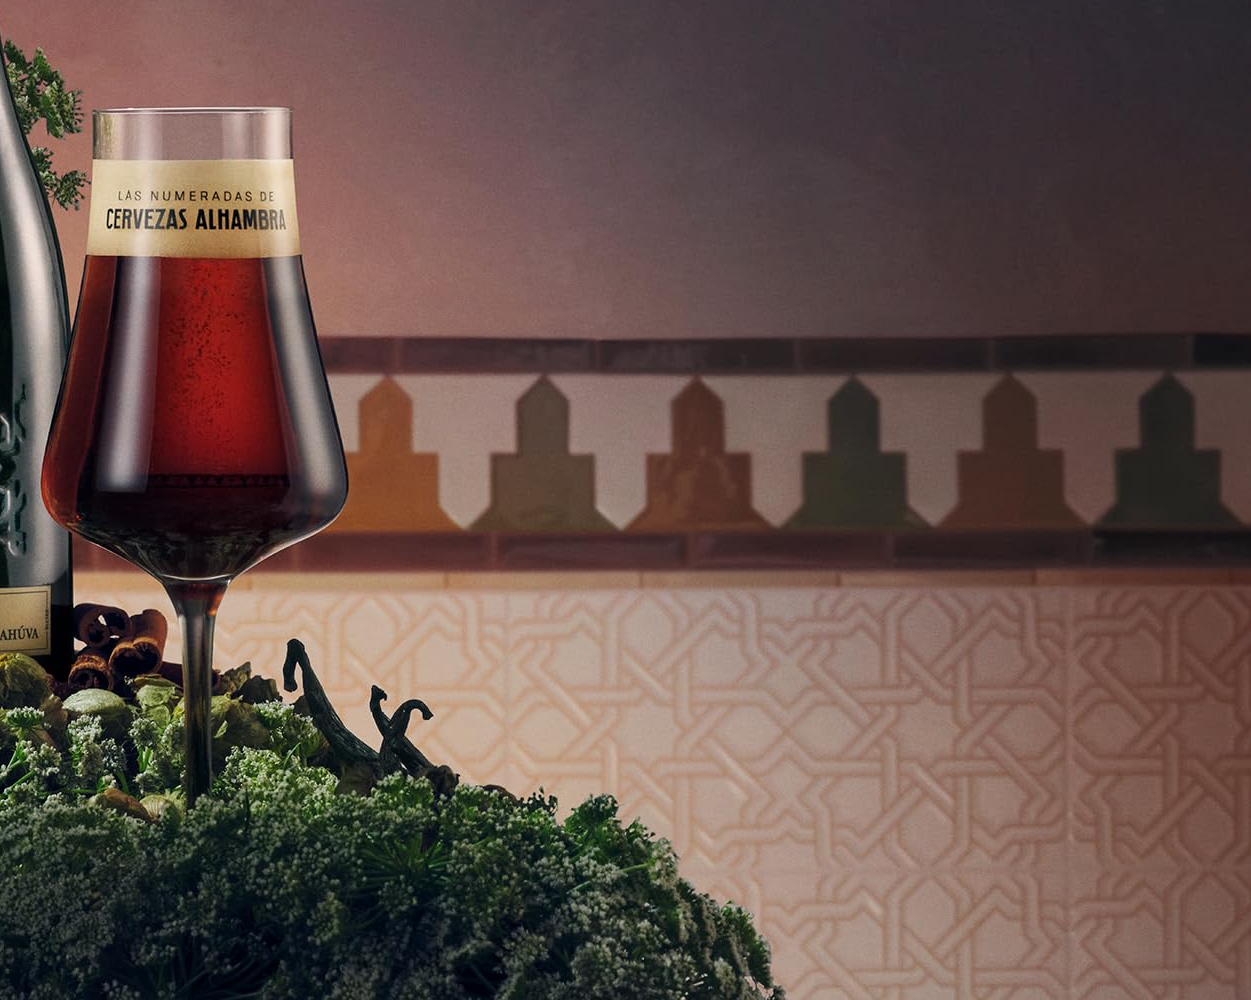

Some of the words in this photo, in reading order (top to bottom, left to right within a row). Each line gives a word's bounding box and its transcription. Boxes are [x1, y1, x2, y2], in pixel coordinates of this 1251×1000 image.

[118, 190, 142, 201] LAS
[150, 190, 253, 202] NUMERADAS
[260, 191, 275, 202] DE
[106, 208, 188, 230] CERVEZAS
[195, 208, 287, 230] ALHAMBRA
